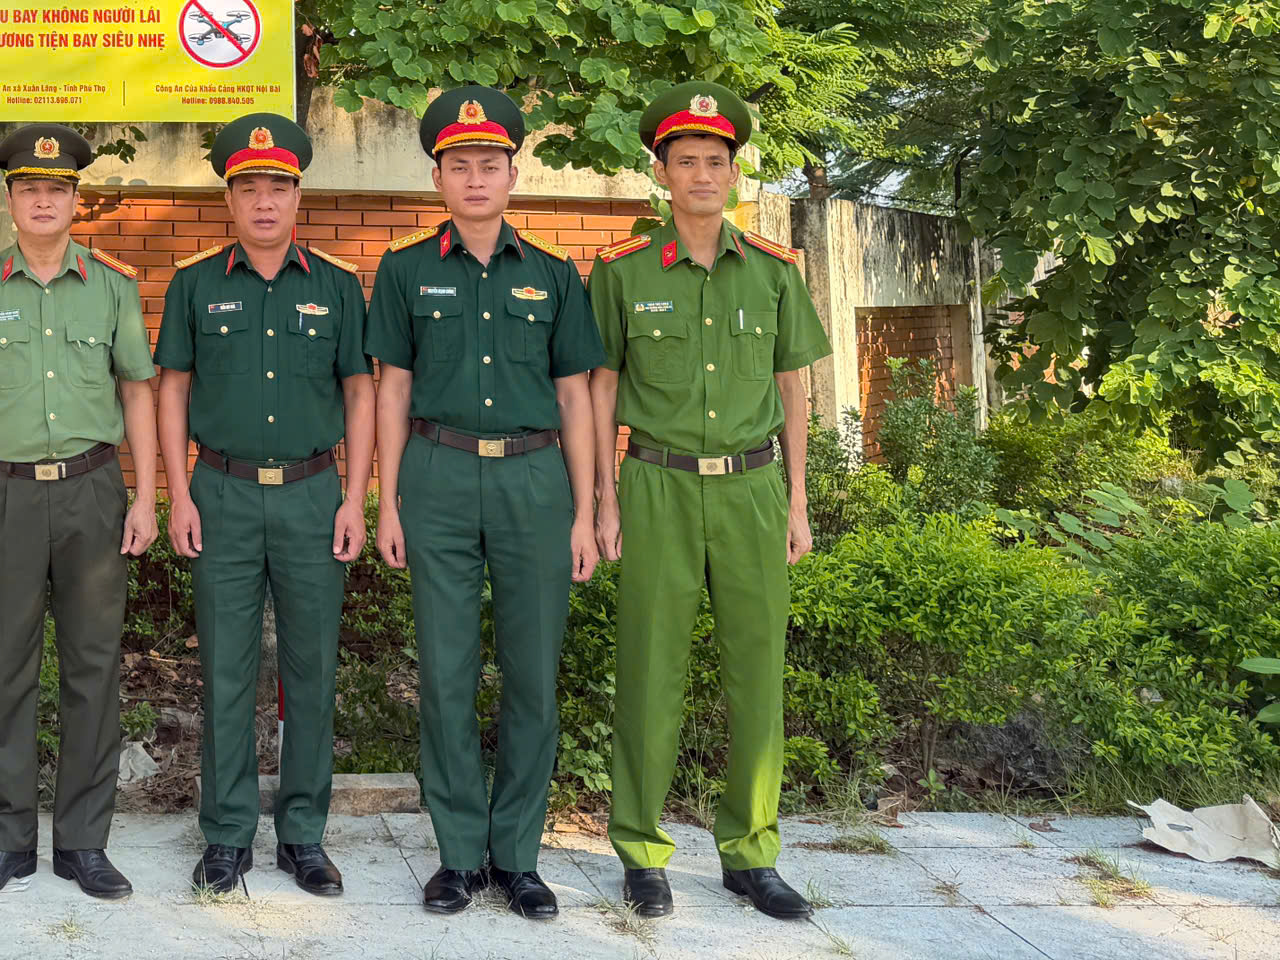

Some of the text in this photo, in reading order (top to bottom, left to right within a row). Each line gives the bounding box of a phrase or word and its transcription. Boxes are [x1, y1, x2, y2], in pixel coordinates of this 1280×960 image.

[13, 9, 39, 23] BAY
[42, 6, 89, 23] KHÔNG
[93, 5, 135, 23] NGƯỜI
[139, 6, 161, 23] LÁI
[38, 30, 69, 51] TIỆN
[73, 33, 98, 47] BAY
[102, 30, 133, 48] SIÊU
[138, 33, 165, 51] NHẸ
[2, 84, 11, 92] An
[174, 84, 183, 92] An
[6, 96, 32, 104] Hotline:
